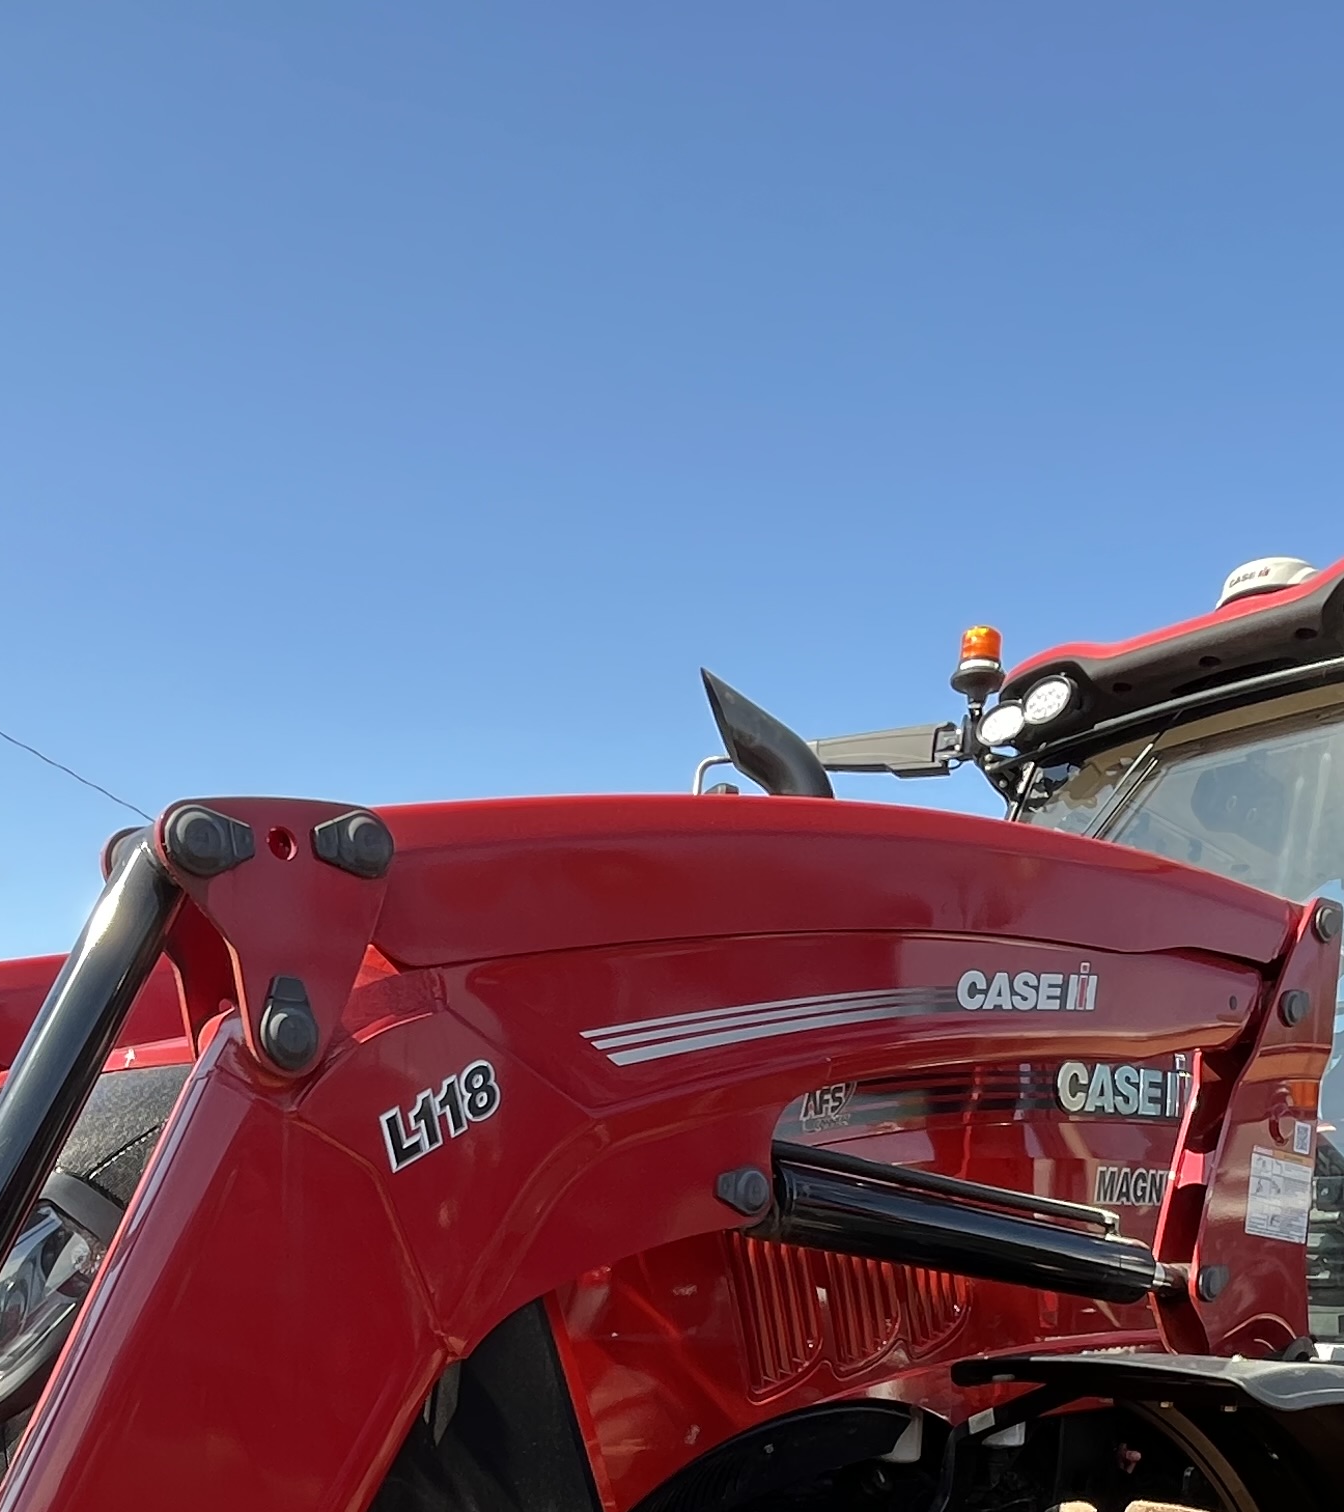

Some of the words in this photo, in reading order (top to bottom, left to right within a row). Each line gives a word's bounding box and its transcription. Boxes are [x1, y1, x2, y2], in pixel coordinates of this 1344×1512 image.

[1229, 571, 1256, 588] CASE
[957, 969, 1064, 1011] CASE
[1057, 1061, 1163, 1116] CASE
[379, 1059, 501, 1173] L118
[1094, 1166, 1170, 1207] MAGN
